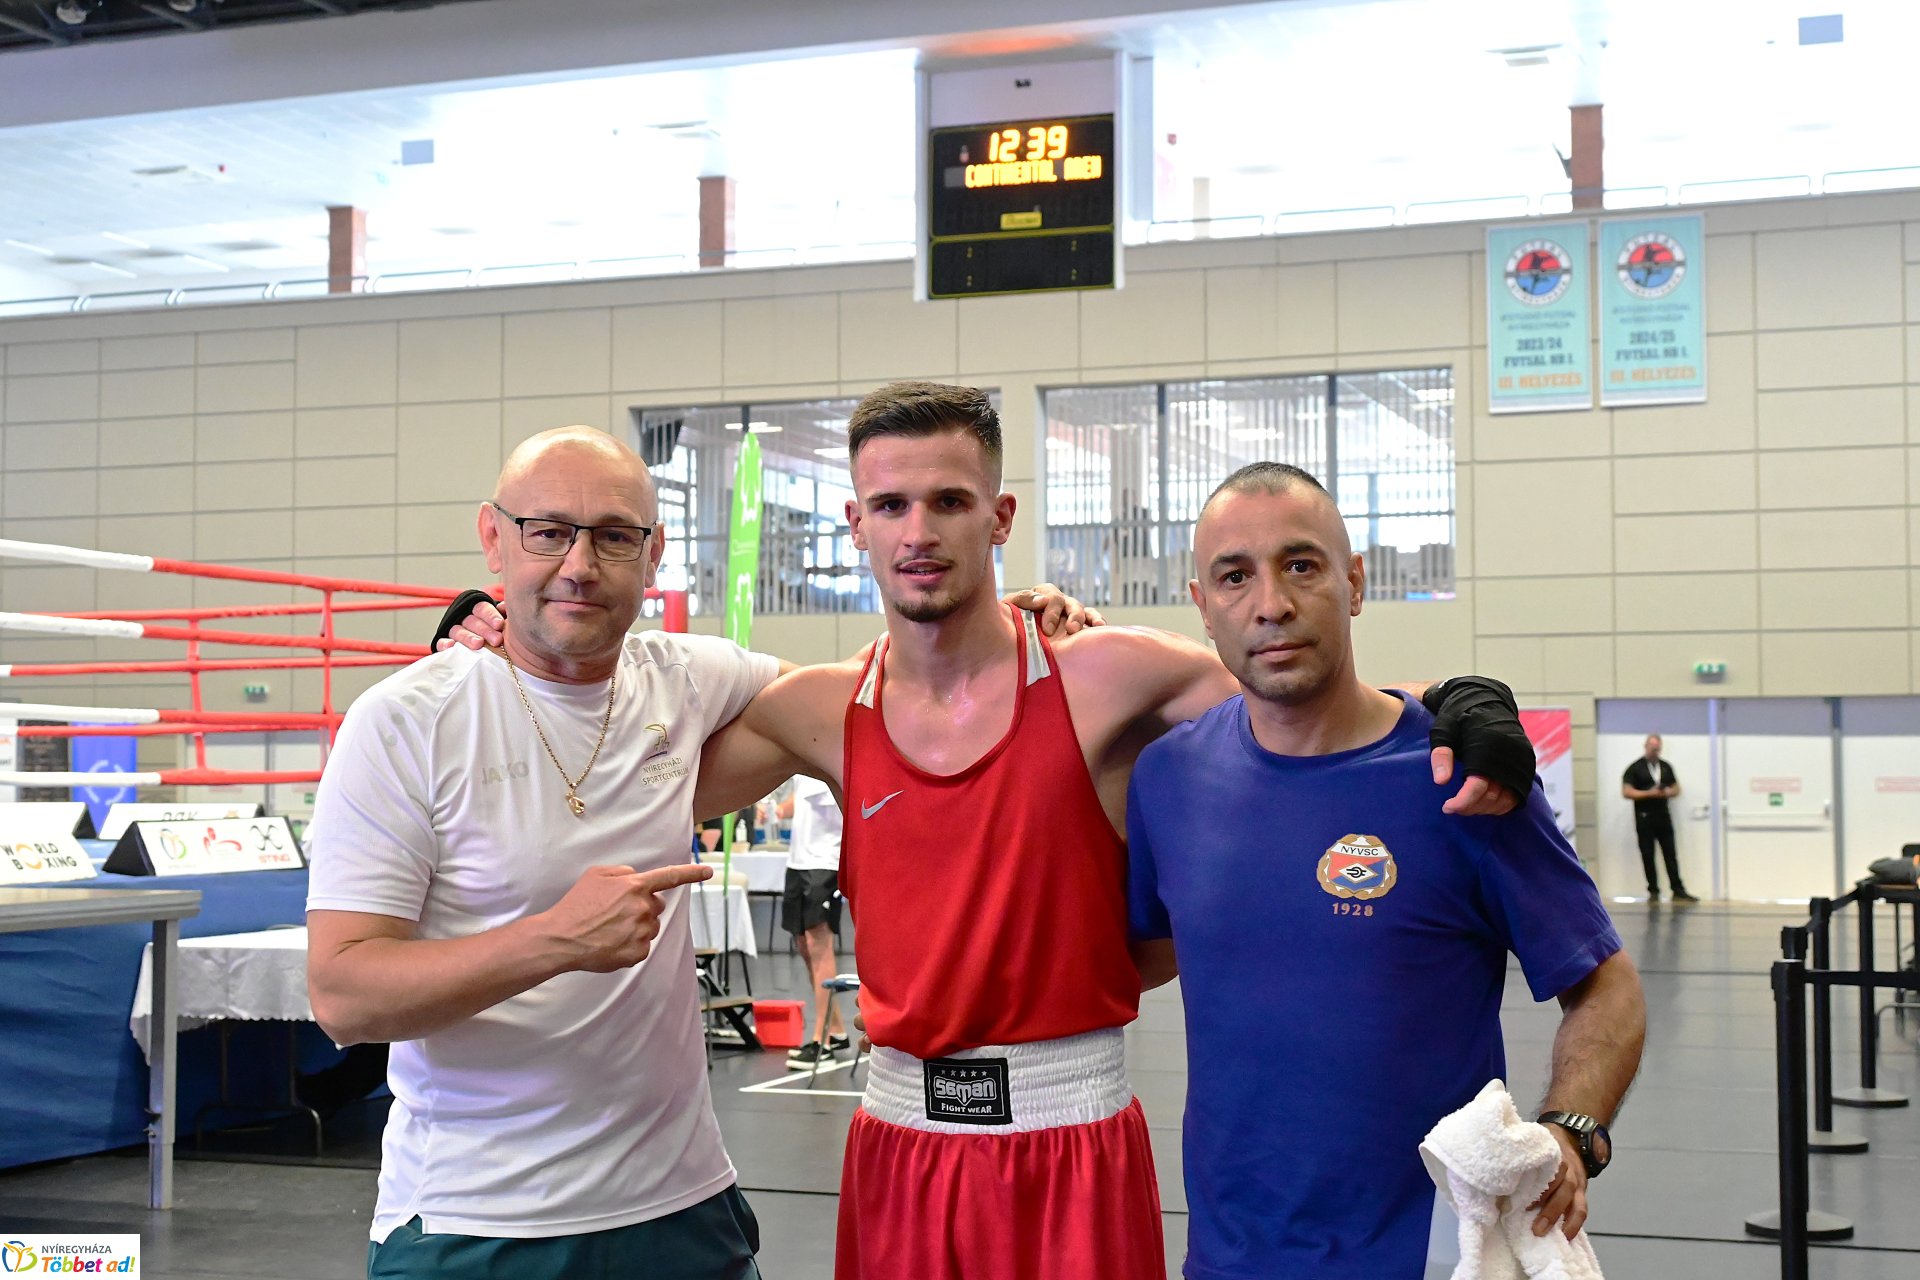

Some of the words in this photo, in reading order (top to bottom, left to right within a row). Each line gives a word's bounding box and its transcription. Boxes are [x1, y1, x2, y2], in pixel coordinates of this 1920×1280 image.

[1340, 845, 1379, 856] NYVSC
[1332, 902, 1374, 917] 1928
[941, 1102, 966, 1113] FIGHT
[967, 1105, 993, 1114] WEAR
